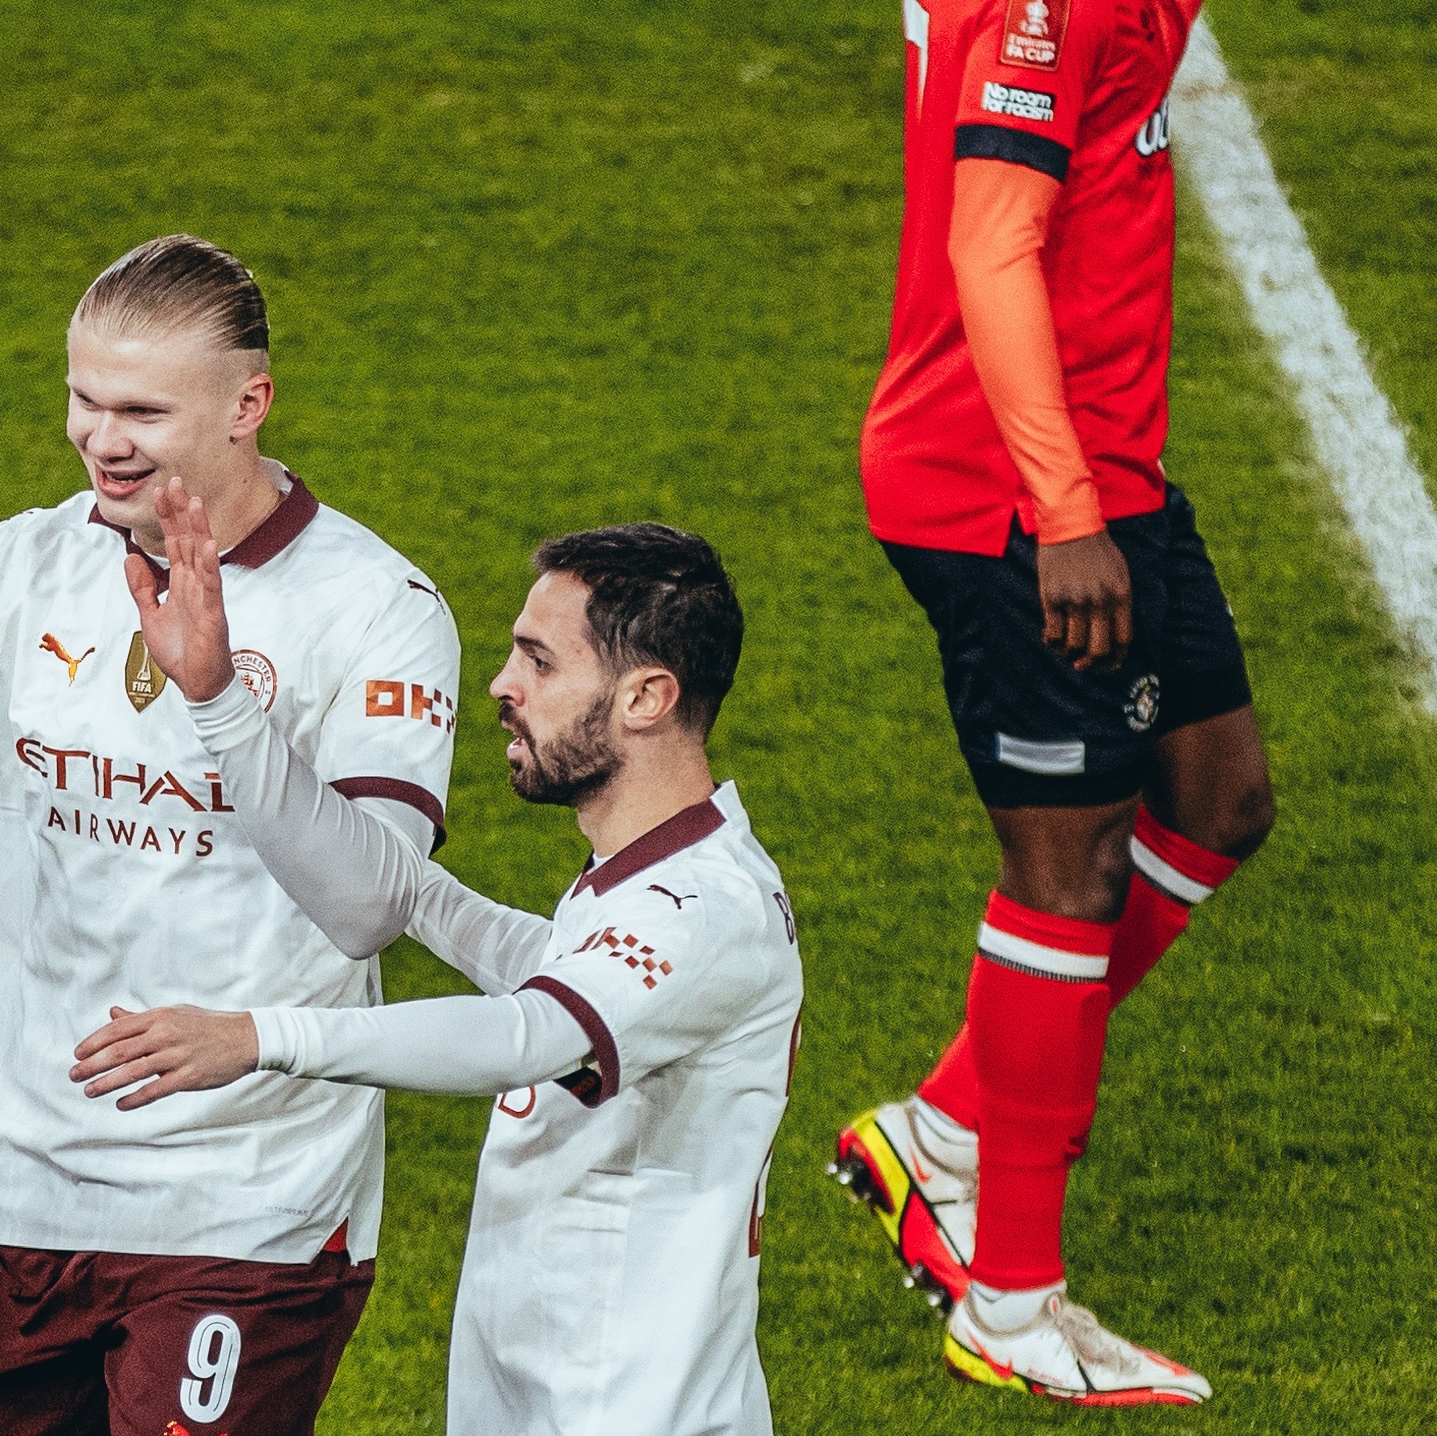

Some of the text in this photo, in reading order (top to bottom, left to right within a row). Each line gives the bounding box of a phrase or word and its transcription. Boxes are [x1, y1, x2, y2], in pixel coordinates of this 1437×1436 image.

[1006, 44, 1055, 62] FA CUP
[983, 81, 1052, 109] No room
[132, 681, 152, 693] FIFA
[47, 806, 214, 857] AIRWAYS
[179, 1313, 242, 1424] 9
